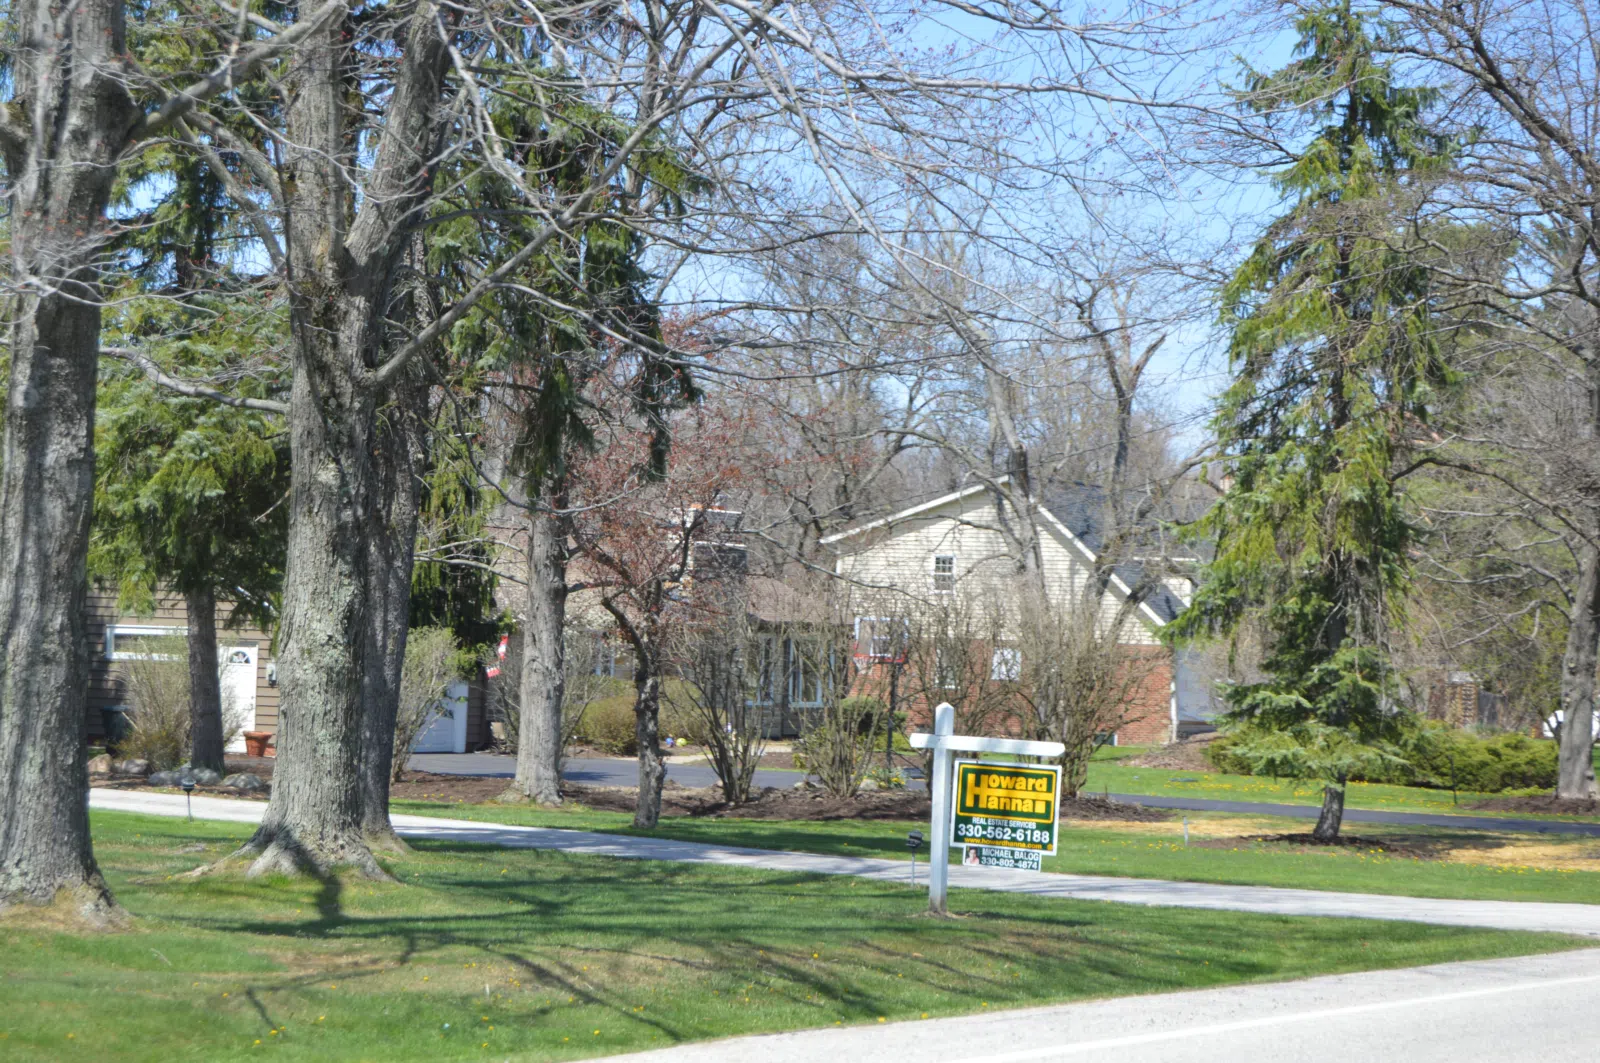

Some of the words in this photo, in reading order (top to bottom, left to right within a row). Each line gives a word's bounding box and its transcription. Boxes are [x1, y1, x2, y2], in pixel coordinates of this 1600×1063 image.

[967, 773, 1048, 793] Howard
[965, 790, 1034, 813] Hanna
[972, 816, 987, 825] REAL
[988, 818, 1008, 827] ESTATE
[1008, 820, 1037, 829] SERVICES
[958, 824, 1050, 843] 330-562-6188
[964, 837, 1042, 849] www.howardhanna.com
[982, 848, 1012, 858] MICHAEL
[1014, 851, 1040, 861] BALOG
[981, 857, 1038, 869] 330-802-4874
